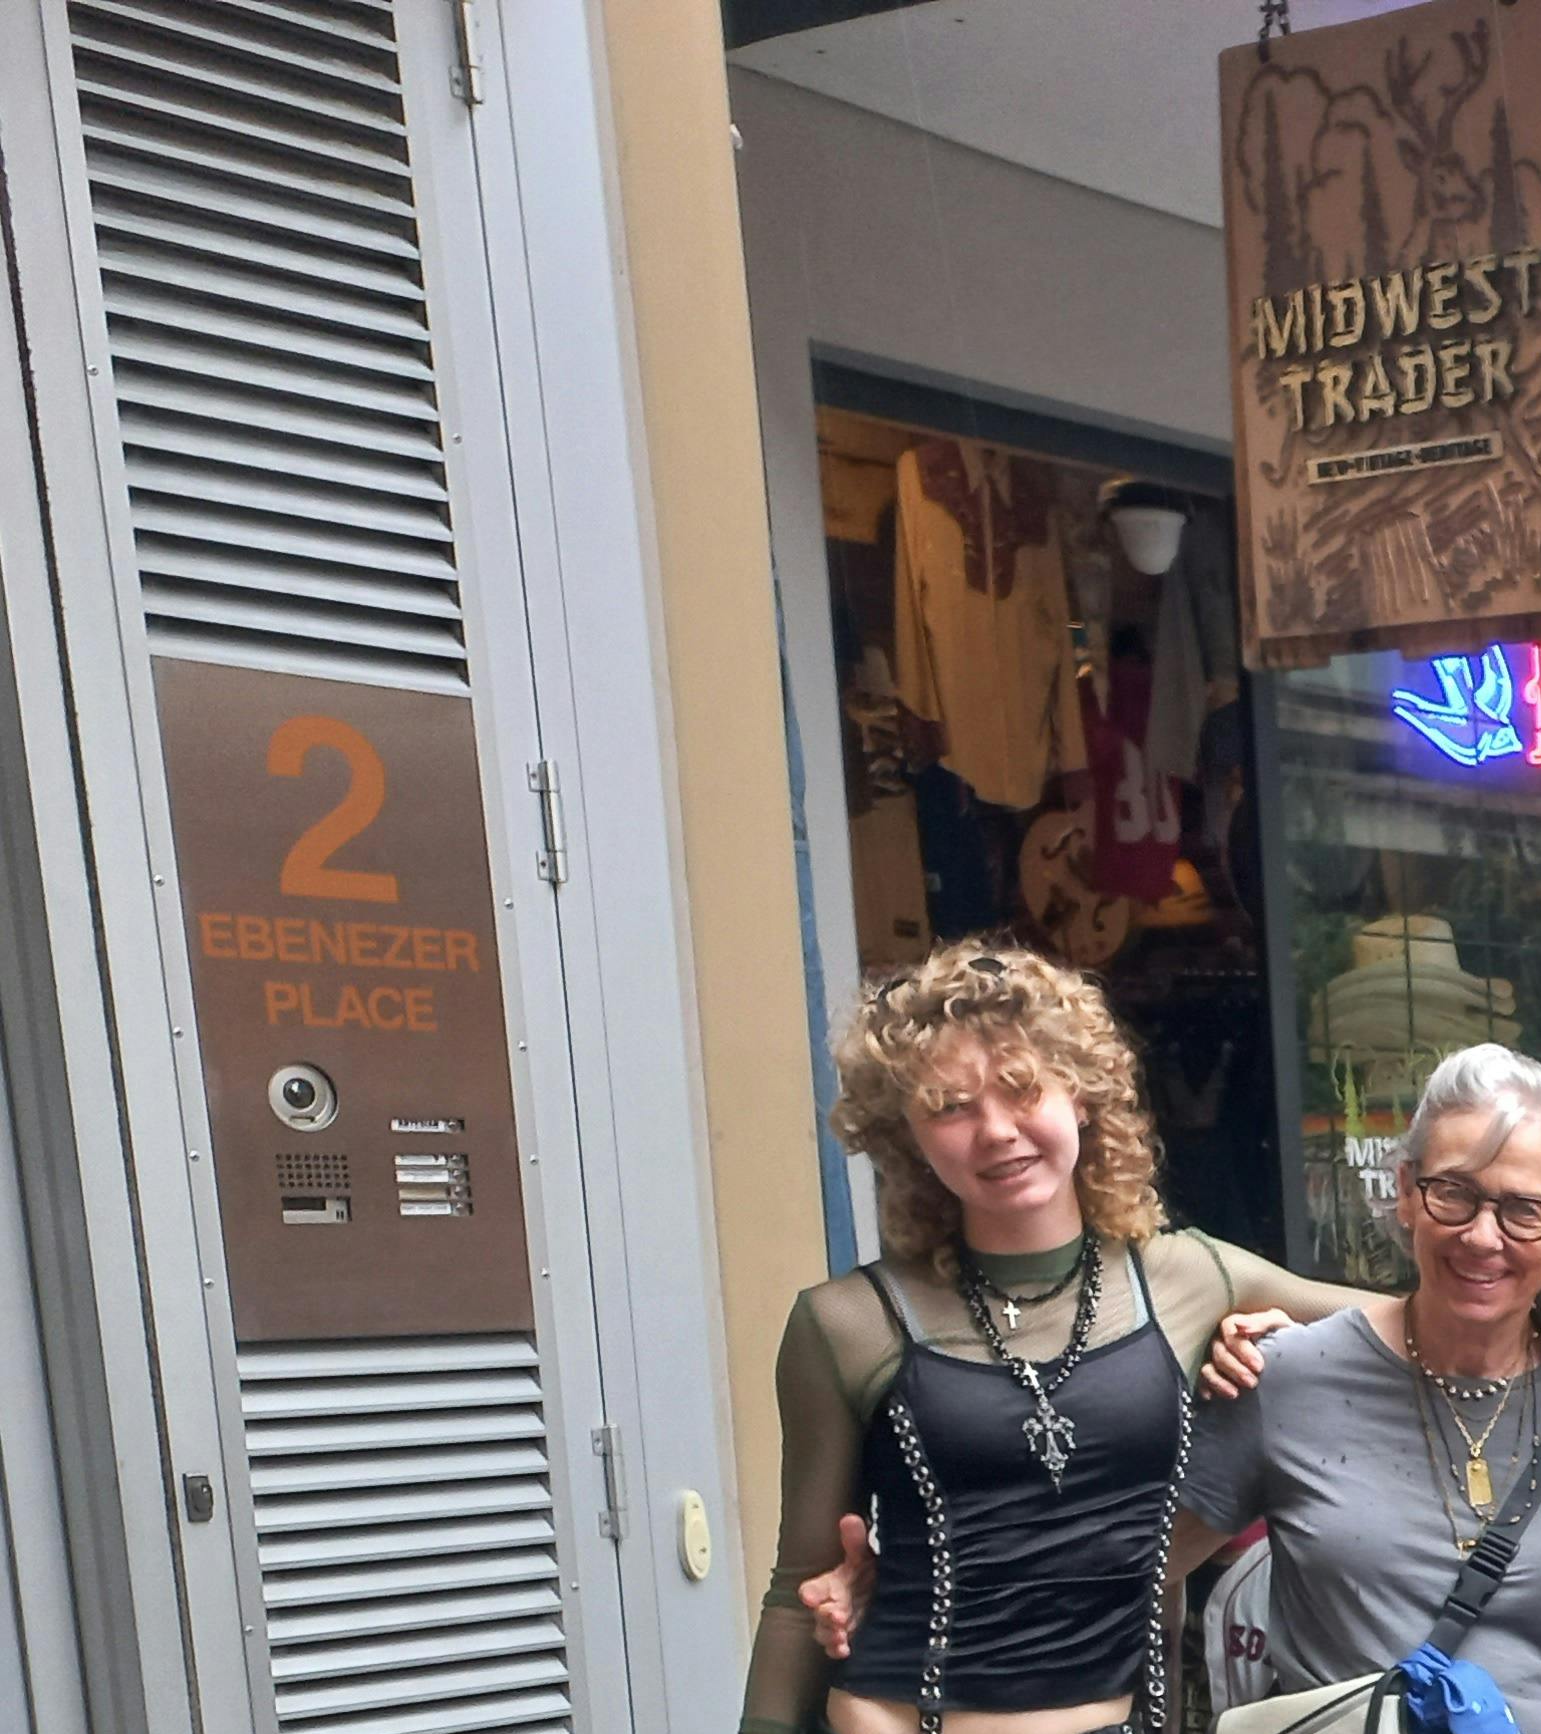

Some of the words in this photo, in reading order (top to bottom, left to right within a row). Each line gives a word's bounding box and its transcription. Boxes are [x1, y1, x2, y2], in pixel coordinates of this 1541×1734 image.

[1278, 335, 1515, 433] TRADER
[266, 714, 401, 905] 2
[200, 913, 480, 974] EBENEZER
[264, 981, 439, 1032] PLACE
